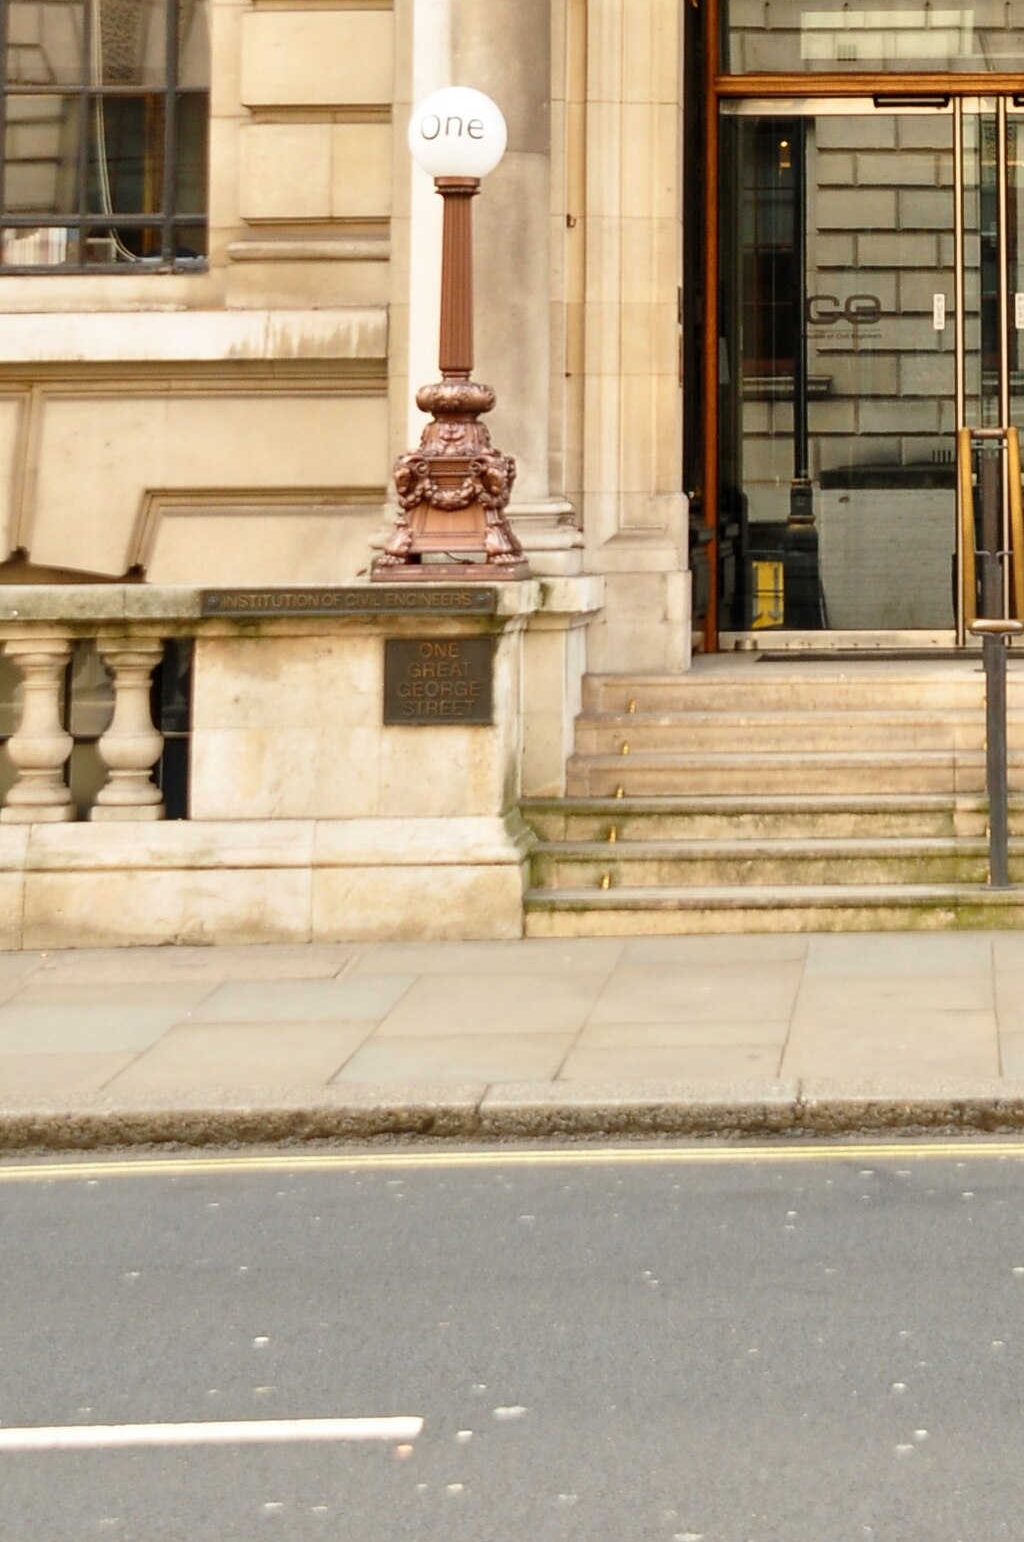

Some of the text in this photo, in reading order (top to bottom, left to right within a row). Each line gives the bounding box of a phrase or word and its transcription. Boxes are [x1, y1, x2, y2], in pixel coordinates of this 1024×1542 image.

[222, 592, 472, 608] INSTITUTION OF CIVIL ENGINEERS
[419, 642, 460, 658] ONE
[408, 661, 472, 677] GREAT
[398, 681, 480, 697] GEORGE
[402, 700, 474, 716] STREET
